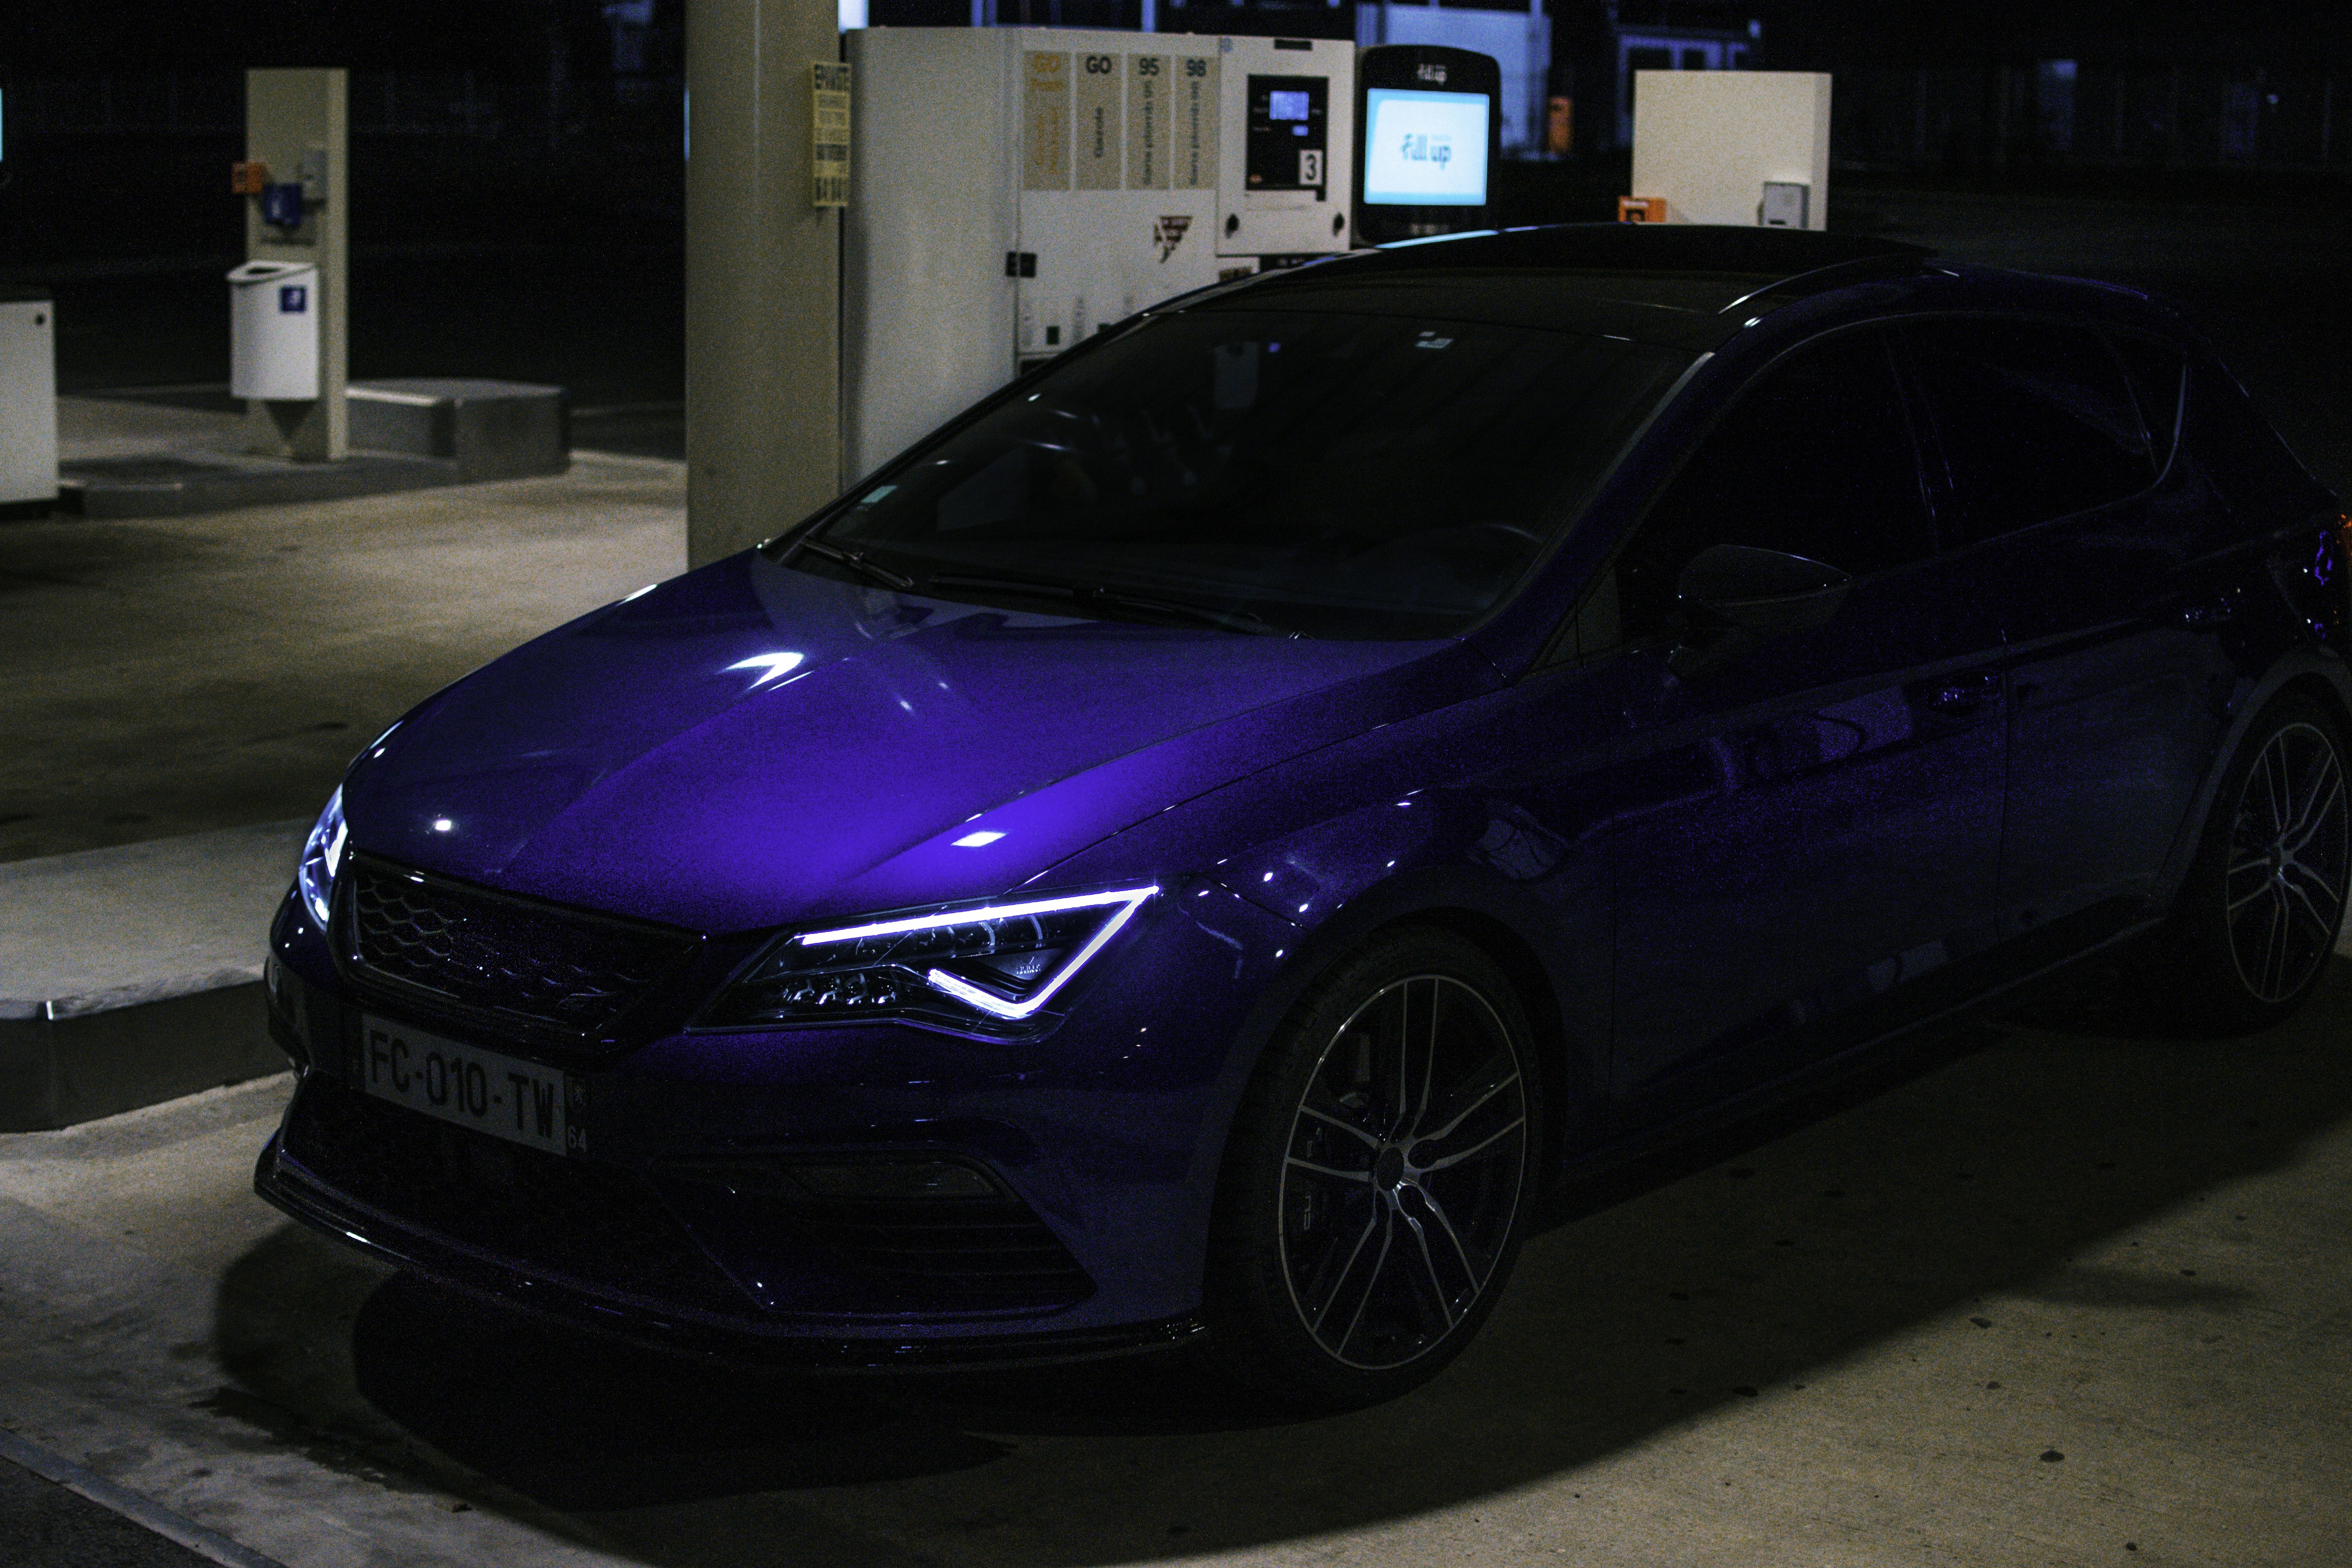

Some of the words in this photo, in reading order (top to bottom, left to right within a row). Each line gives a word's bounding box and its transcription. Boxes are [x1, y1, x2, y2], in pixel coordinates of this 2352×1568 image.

[1033, 55, 1061, 74] GO
[1085, 55, 1112, 74] GO
[1139, 57, 1160, 76] 95
[1186, 58, 1207, 77] 98
[1094, 106, 1105, 158] Gazole
[1305, 154, 1317, 181] 3
[370, 1028, 554, 1139] FC-010-TW
[567, 1124, 587, 1154] 64
